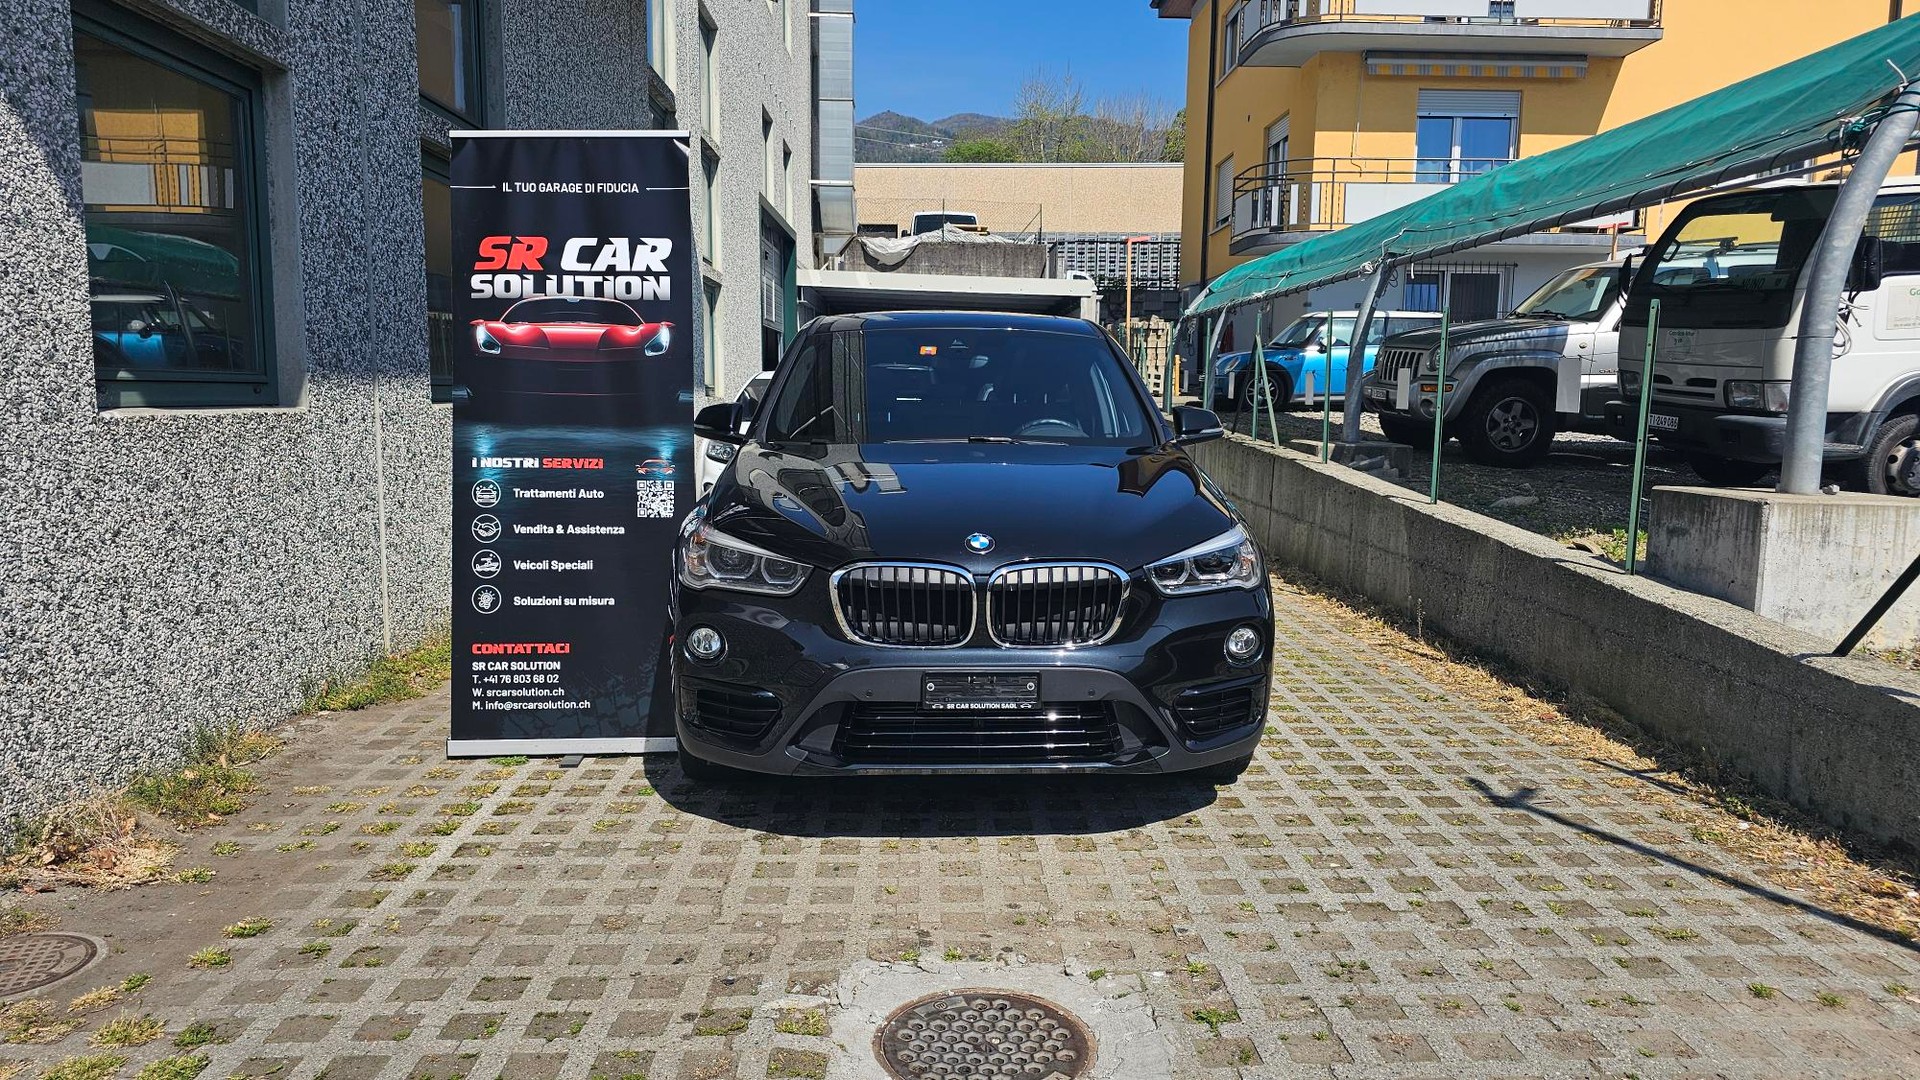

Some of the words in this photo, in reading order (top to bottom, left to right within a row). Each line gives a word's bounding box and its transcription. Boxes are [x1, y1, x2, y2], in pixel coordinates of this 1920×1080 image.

[502, 182, 512, 193] IL
[514, 182, 536, 193] TUO
[538, 183, 582, 194] GARAGE
[585, 184, 595, 194] DI
[597, 183, 639, 194] FIDUCIA
[474, 236, 548, 271] SR
[560, 237, 673, 272] CAR
[471, 274, 671, 301] SOLUTION
[472, 458, 478, 468] I
[480, 458, 540, 469] NOSTRI
[542, 458, 604, 470] SERVIZI
[513, 488, 576, 499] Trattamenti
[579, 489, 604, 499] Auto
[513, 524, 554, 535] Vendita
[556, 525, 564, 535] &
[567, 524, 625, 535] Assistenza
[513, 560, 549, 571] Veicoli
[551, 560, 594, 573] Speciali
[513, 595, 562, 607] Soluzioni
[564, 598, 577, 607] su
[579, 596, 615, 607] misura
[472, 643, 570, 655] CONTATTACI
[472, 662, 487, 671] SR
[487, 662, 509, 671] CAR
[510, 661, 561, 671] SOLUTION
[472, 675, 482, 684] T.
[483, 675, 499, 684] +41
[500, 675, 512, 684] 76
[513, 675, 532, 684] 803
[533, 674, 545, 684] 68
[546, 674, 560, 684] 02
[472, 688, 485, 697] W.
[486, 687, 565, 697] srcarsolution.ch
[472, 701, 483, 710] M.
[485, 699, 591, 711] info@srcarsolution.ch
